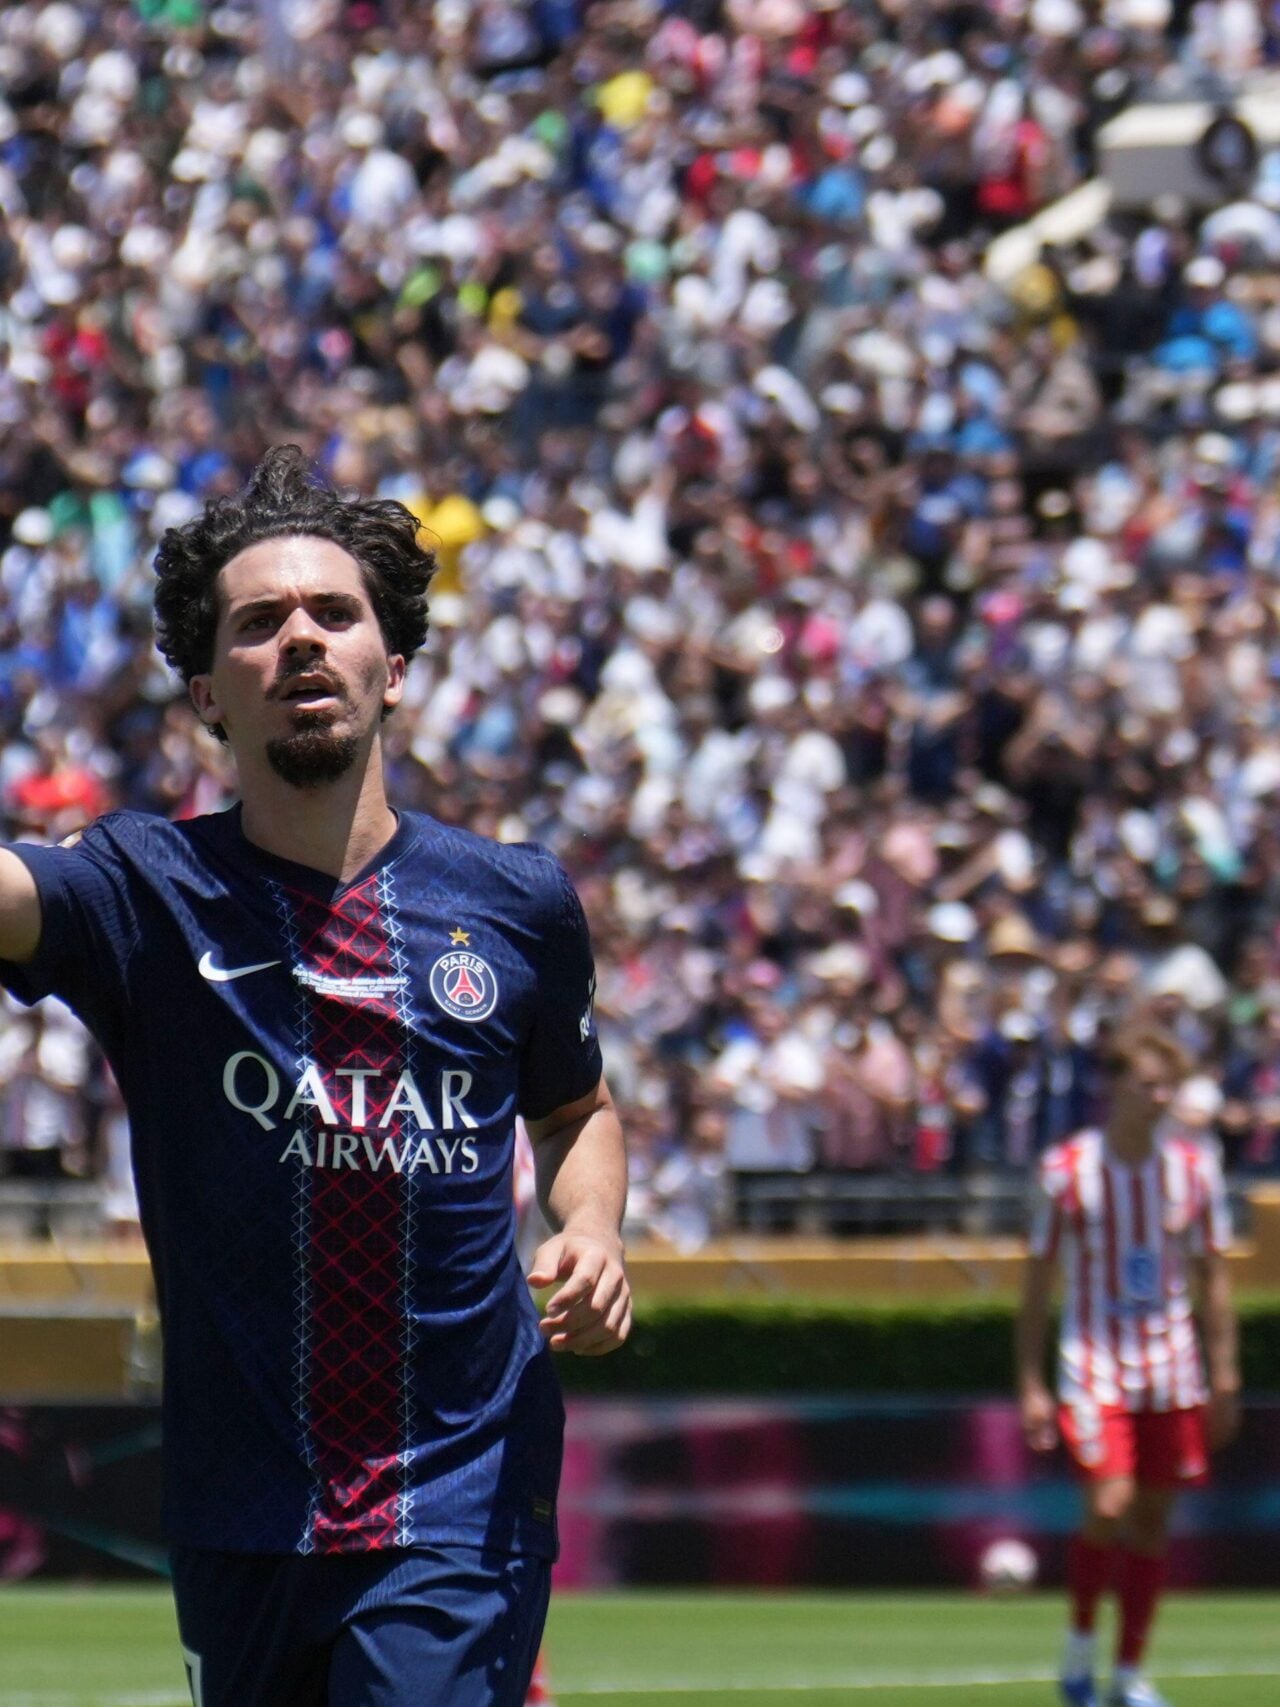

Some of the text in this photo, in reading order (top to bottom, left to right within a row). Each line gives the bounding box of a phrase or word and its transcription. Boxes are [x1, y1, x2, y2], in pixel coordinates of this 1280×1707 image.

[439, 954, 485, 974] PARIS
[222, 1050, 480, 1132] QATAR
[278, 1129, 480, 1175] AIRWAYS
